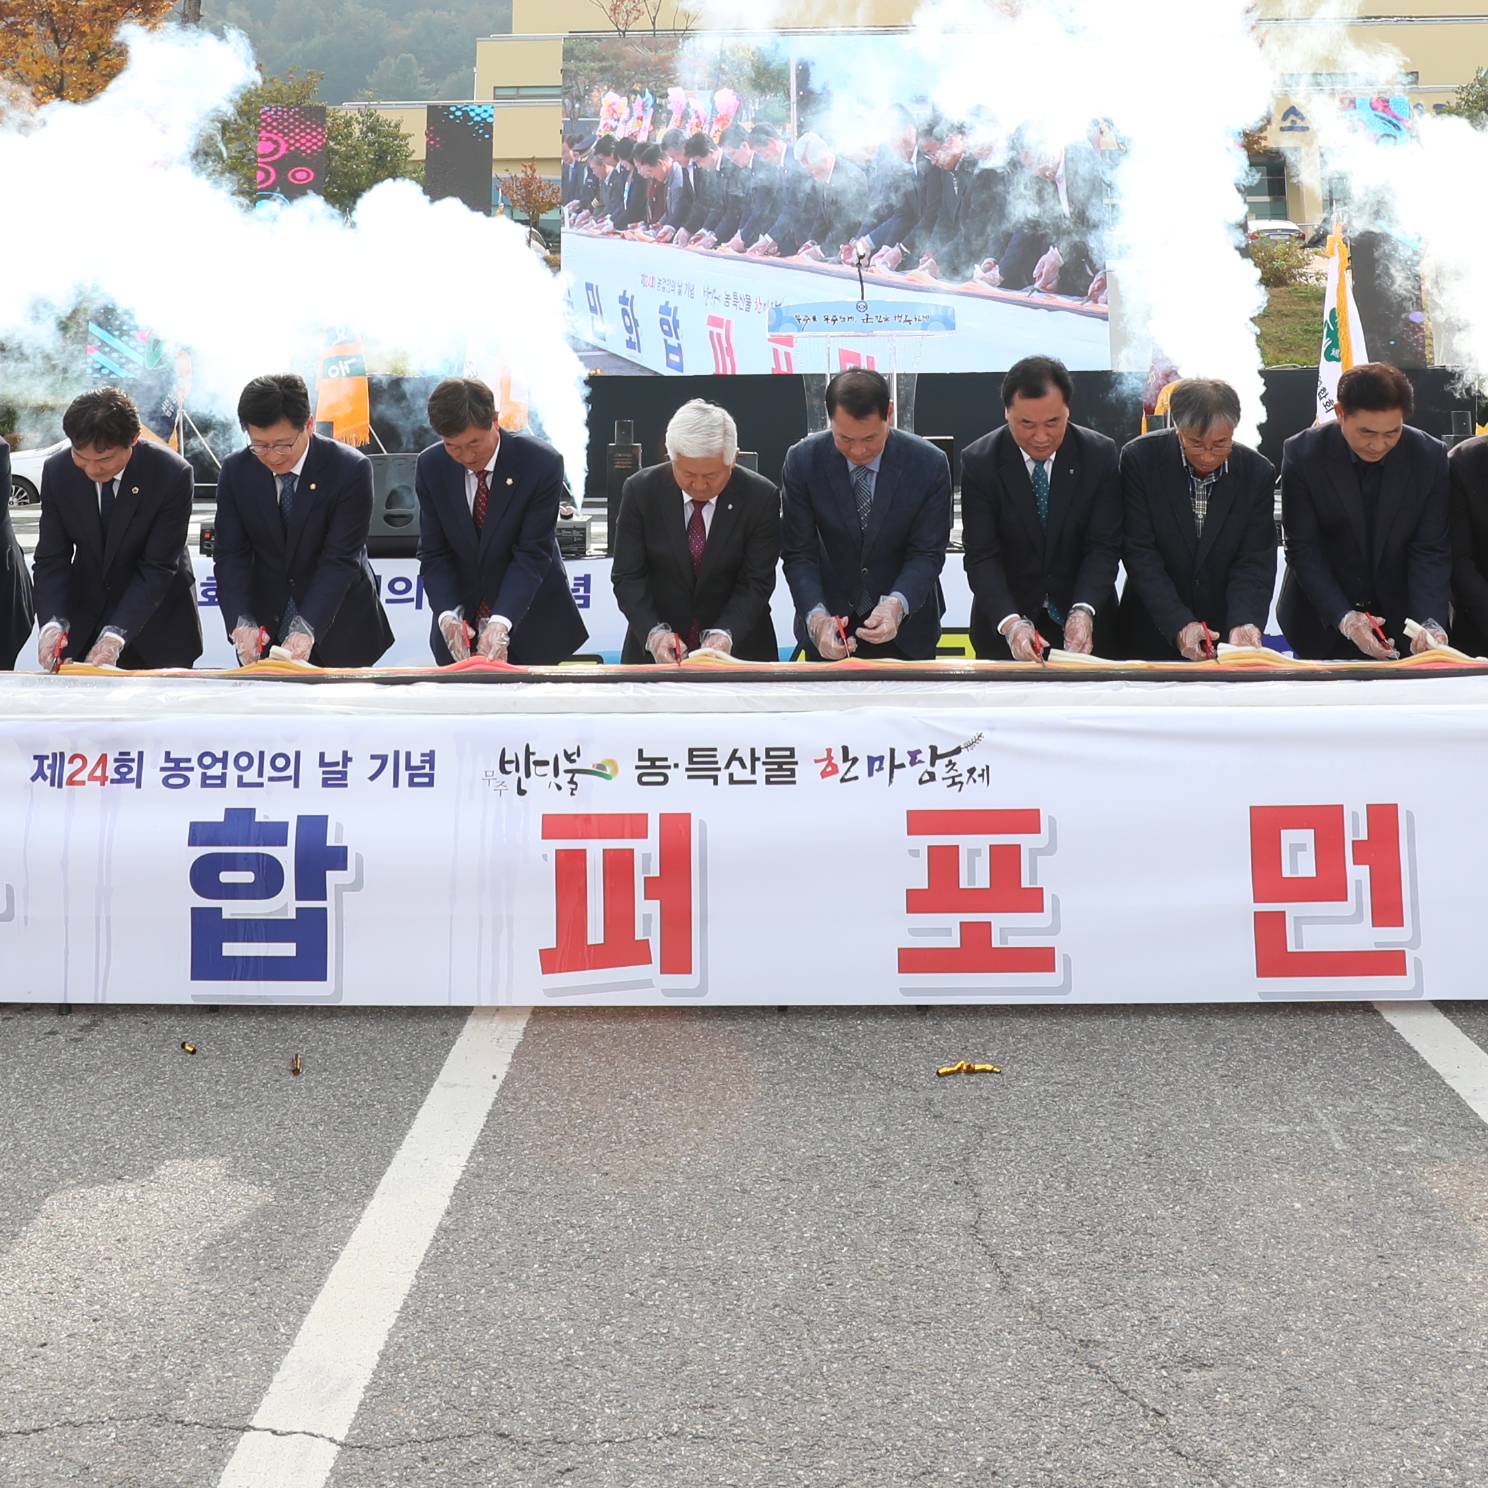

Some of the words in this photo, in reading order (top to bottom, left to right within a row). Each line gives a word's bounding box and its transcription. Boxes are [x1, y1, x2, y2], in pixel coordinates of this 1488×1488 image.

[618, 289, 642, 353] 화
[658, 300, 684, 373] 합
[29, 750, 143, 790] 제24회
[159, 750, 300, 790] 농업인의
[318, 749, 352, 789] 날
[368, 749, 435, 789] 기념
[813, 744, 963, 788] 한마당
[941, 759, 991, 793] 축제
